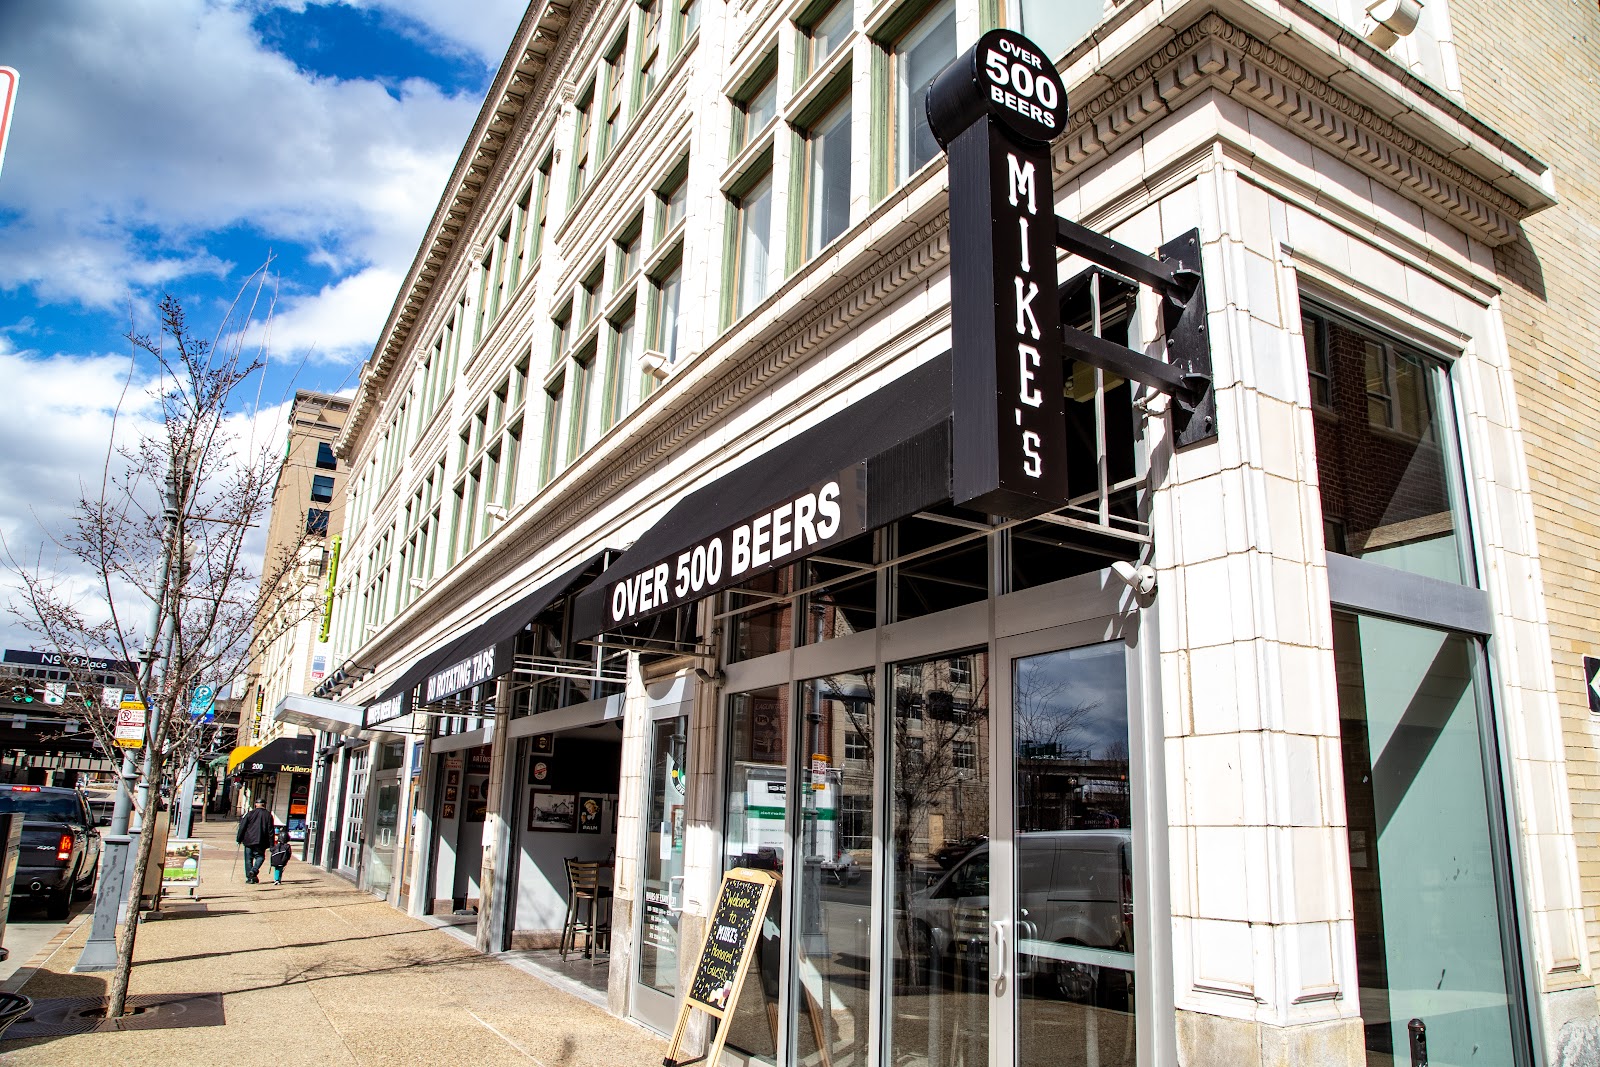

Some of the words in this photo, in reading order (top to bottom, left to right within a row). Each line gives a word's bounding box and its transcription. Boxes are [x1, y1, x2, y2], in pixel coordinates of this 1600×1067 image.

[985, 48, 1058, 110] 500
[999, 38, 1042, 71] OVER
[990, 84, 1056, 129] BEERS
[1006, 152, 1043, 479] MIKE'S
[611, 562, 670, 622] OVER
[675, 537, 723, 598] 500
[731, 481, 841, 577] BEERS
[427, 677, 437, 702] 80
[436, 660, 471, 698] ROTATING
[472, 648, 495, 682] TAPS
[728, 910, 737, 924] to
